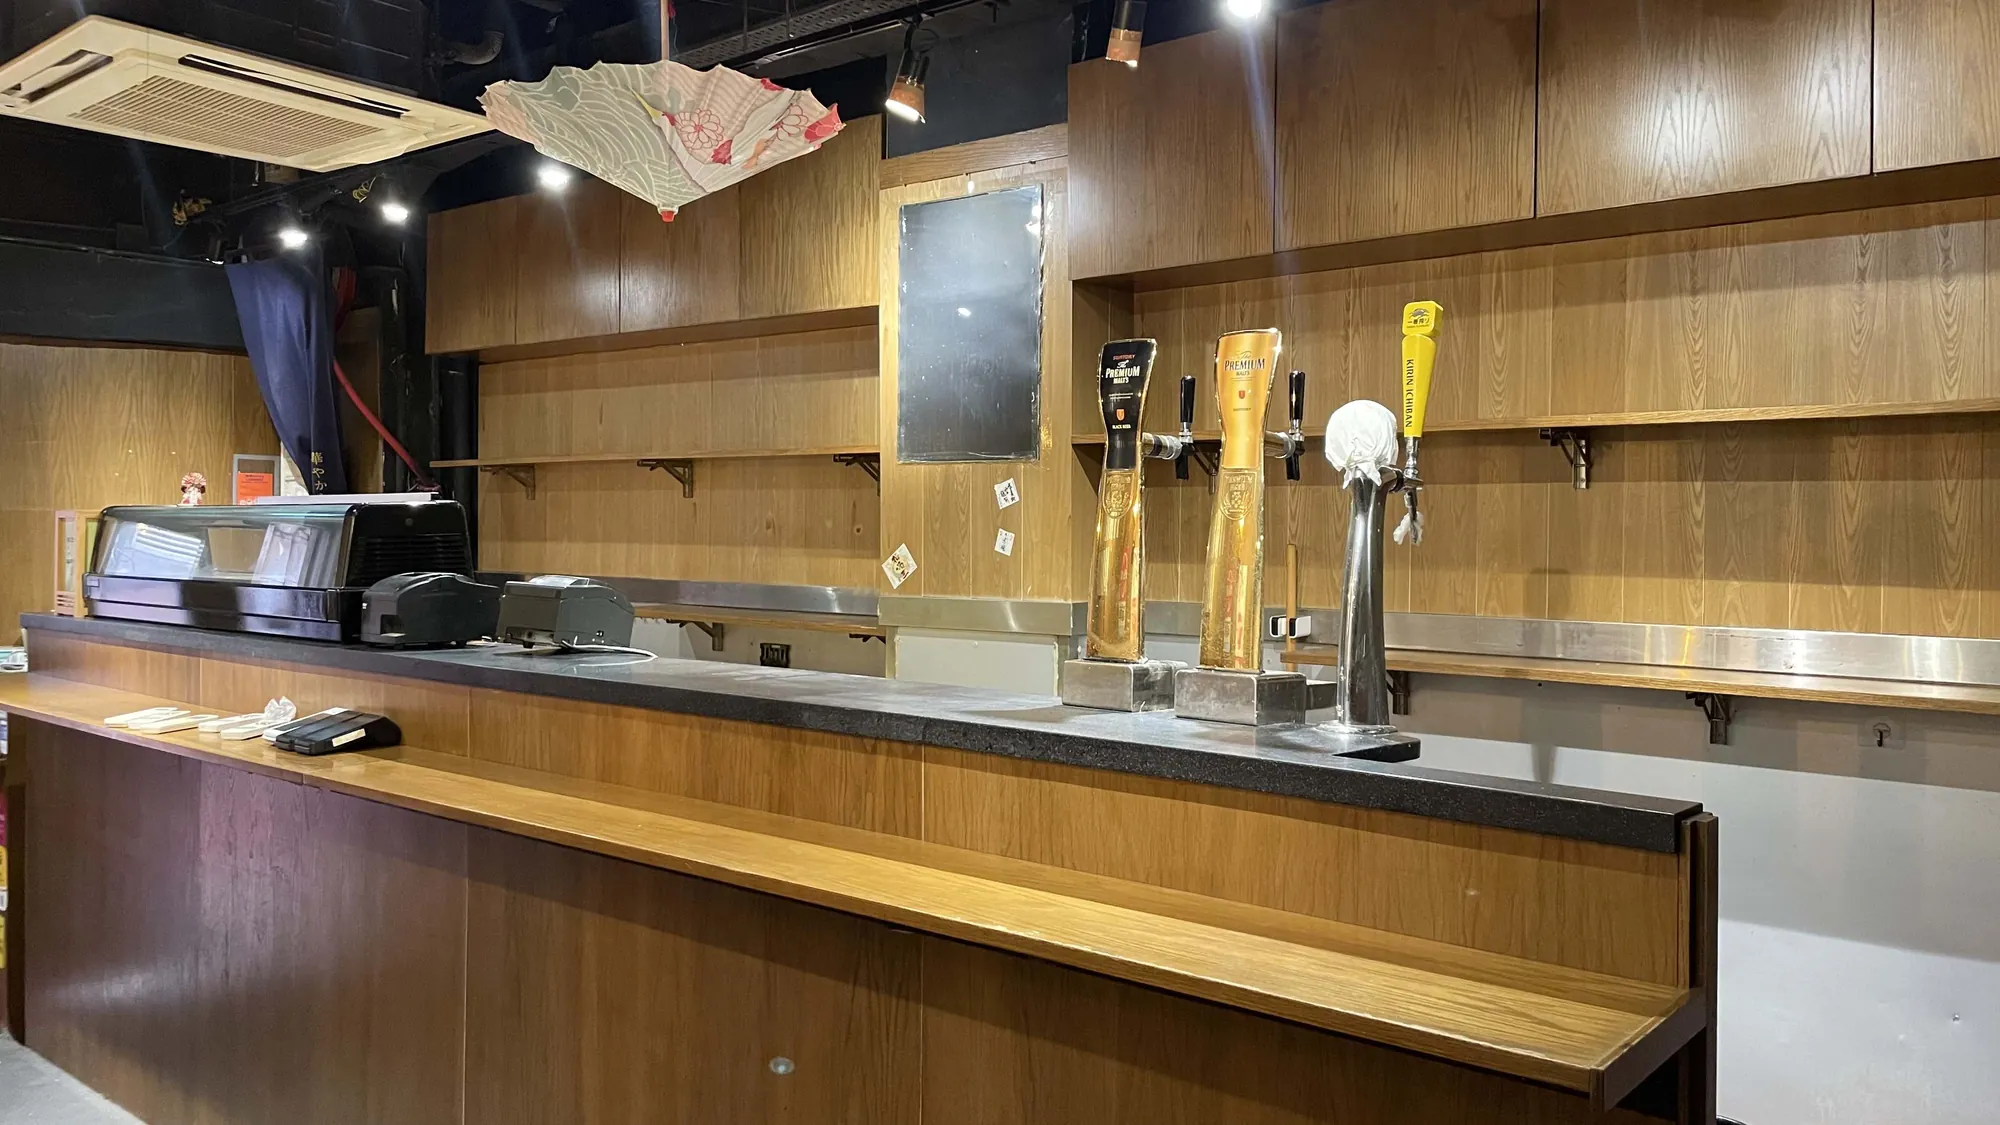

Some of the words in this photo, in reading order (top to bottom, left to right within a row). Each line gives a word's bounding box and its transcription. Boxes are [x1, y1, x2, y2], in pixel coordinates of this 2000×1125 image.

[1105, 365, 1140, 378] PREMIUM
[1225, 358, 1265, 371] PREMIUM
[1406, 358, 1415, 385] KIRIN
[1405, 389, 1414, 428] ICHIBAN
[311, 451, 328, 495] 華やか
